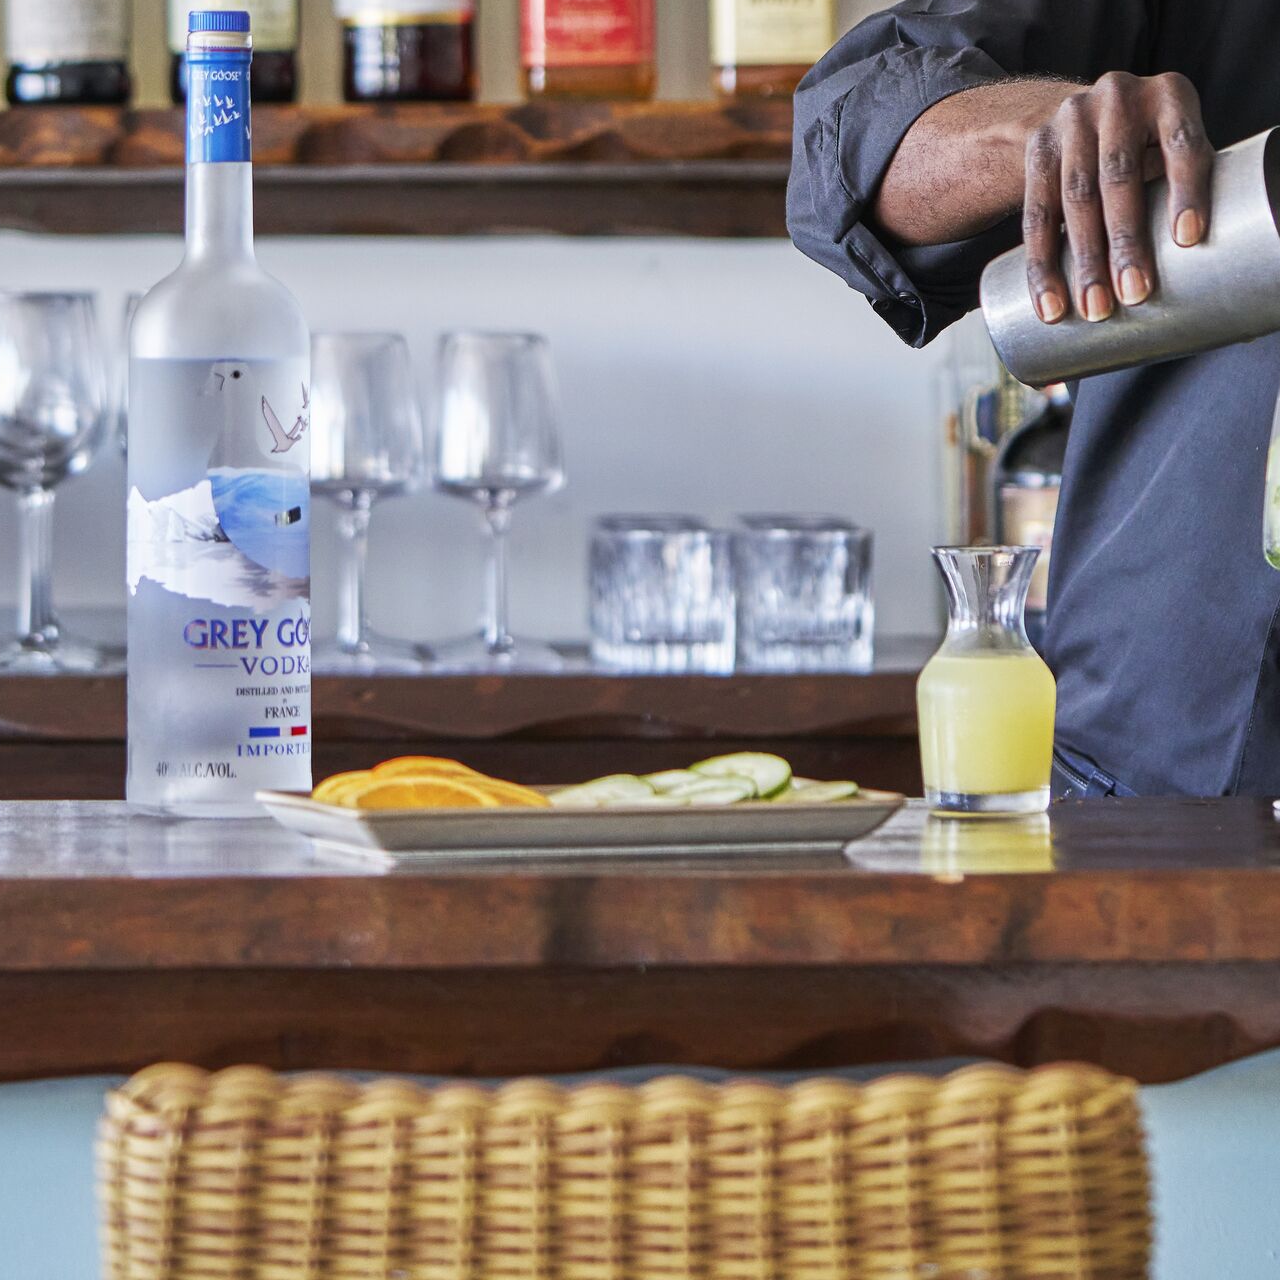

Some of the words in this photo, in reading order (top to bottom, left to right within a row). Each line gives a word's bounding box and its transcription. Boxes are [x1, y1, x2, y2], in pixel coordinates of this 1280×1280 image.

[183, 618, 270, 650] GREY
[235, 686, 279, 697] DISTILLED
[280, 685, 294, 695] AND
[264, 705, 301, 719] FRANCE
